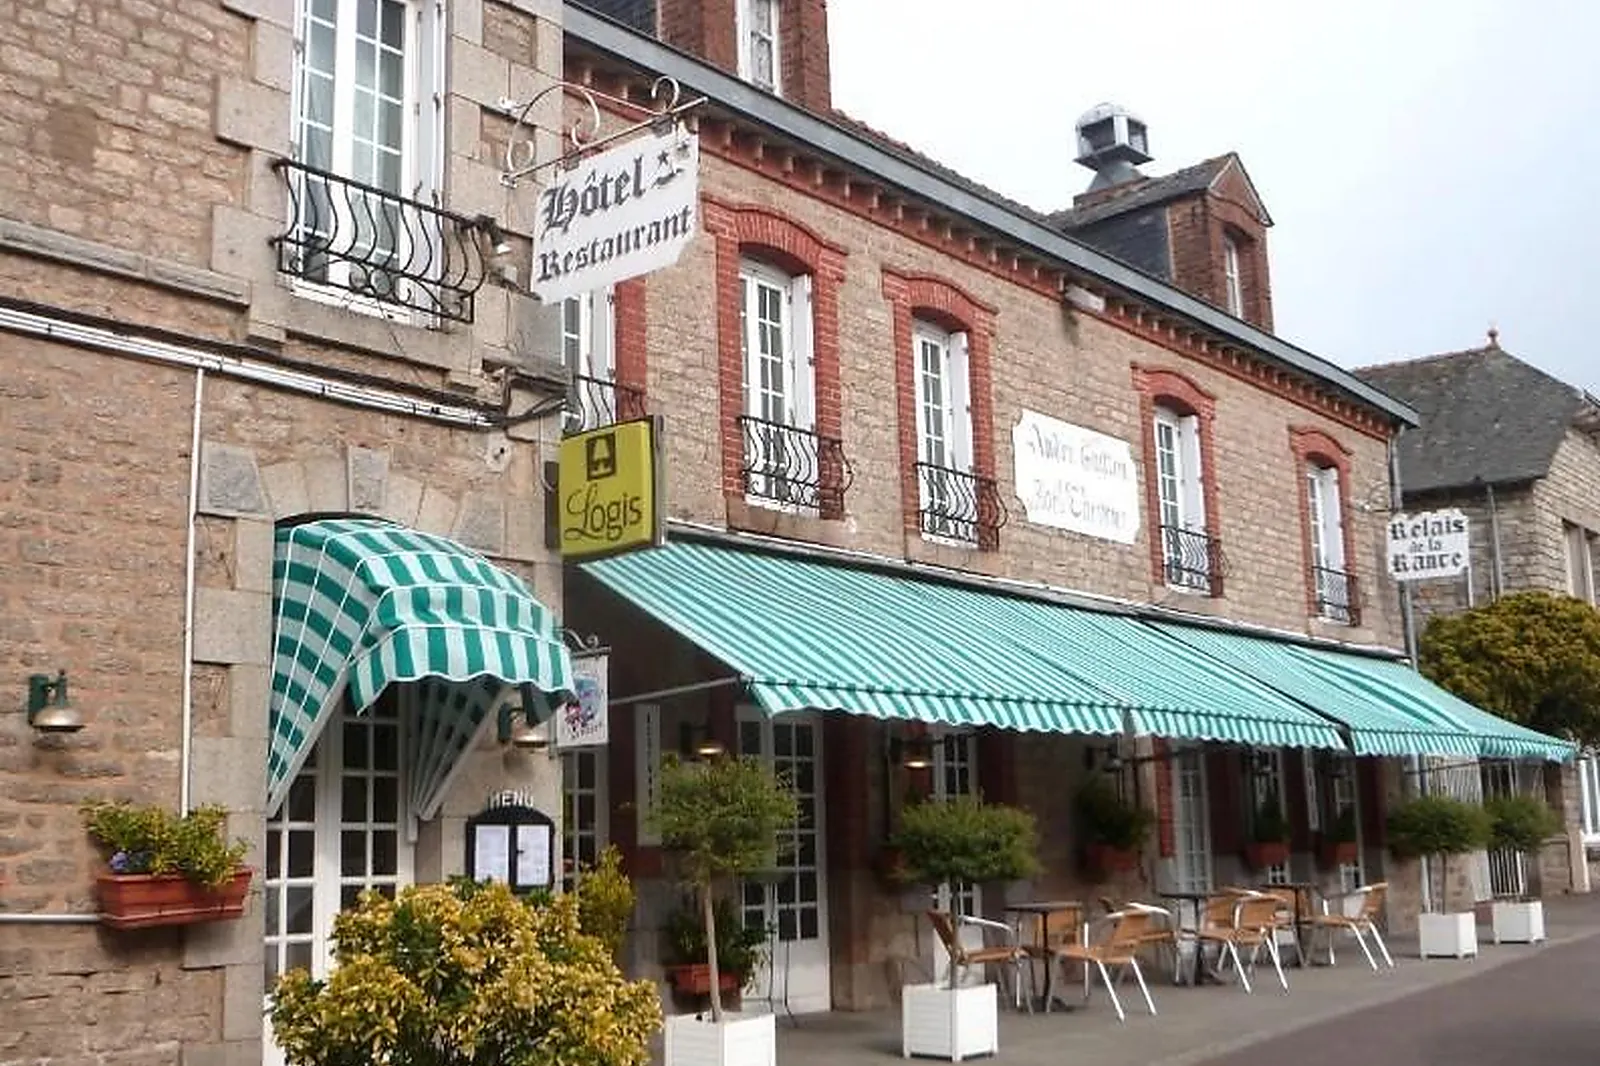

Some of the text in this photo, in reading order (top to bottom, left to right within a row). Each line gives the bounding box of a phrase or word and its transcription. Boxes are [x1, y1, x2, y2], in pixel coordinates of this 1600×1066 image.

[541, 154, 646, 239] Hôtel
[537, 205, 692, 282] Restaurant
[564, 483, 642, 541] Logis
[1391, 516, 1464, 540] Relais
[1428, 537, 1442, 551] la
[1392, 552, 1462, 573] Rance
[487, 789, 534, 809] MENU
